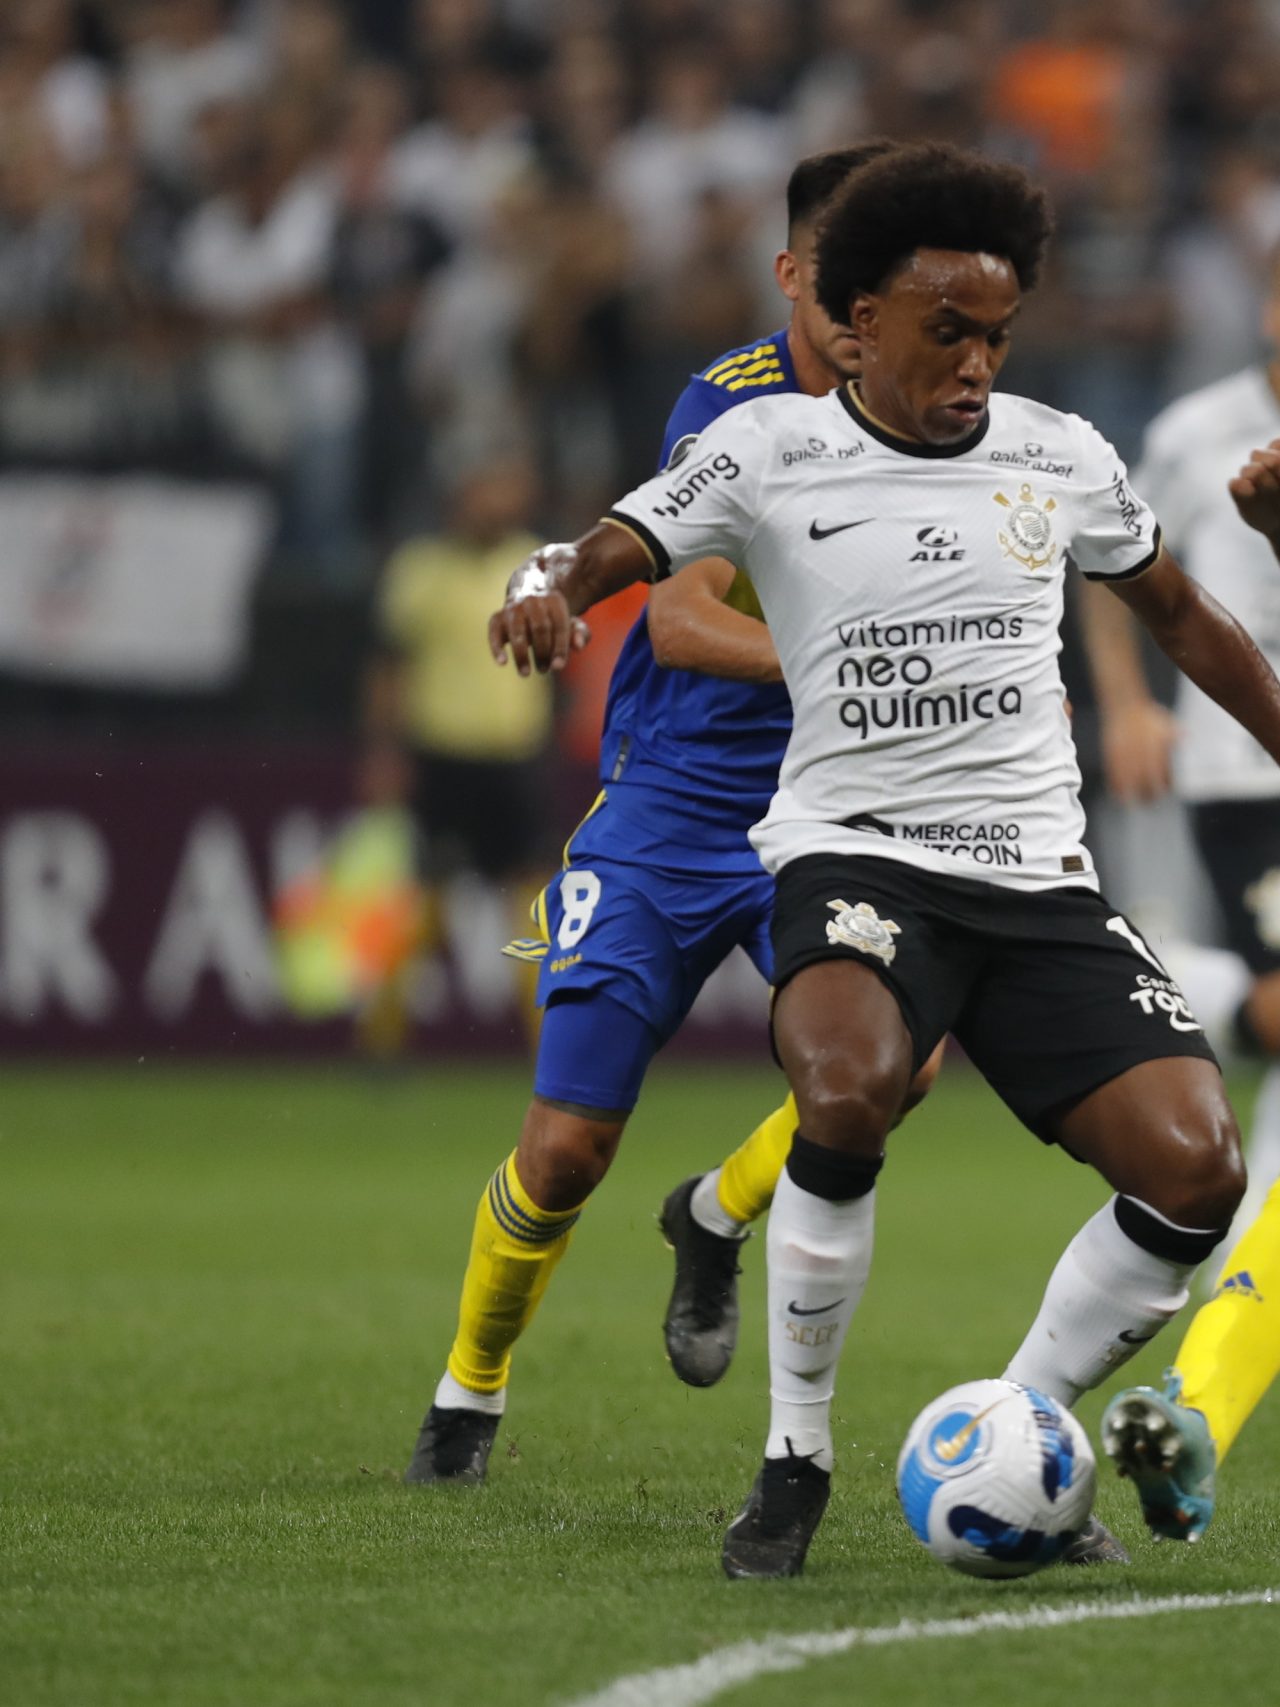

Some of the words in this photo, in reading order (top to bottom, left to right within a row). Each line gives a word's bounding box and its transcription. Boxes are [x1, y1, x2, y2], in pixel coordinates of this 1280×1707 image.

[664, 452, 741, 510] bmg
[908, 549, 966, 562] ALE
[837, 615, 1023, 648] vitaminas
[838, 655, 933, 687] neo
[839, 684, 1023, 740] química
[902, 823, 1020, 841] MERCADO
[912, 843, 1022, 866] TCOIN
[557, 870, 602, 951] 8
